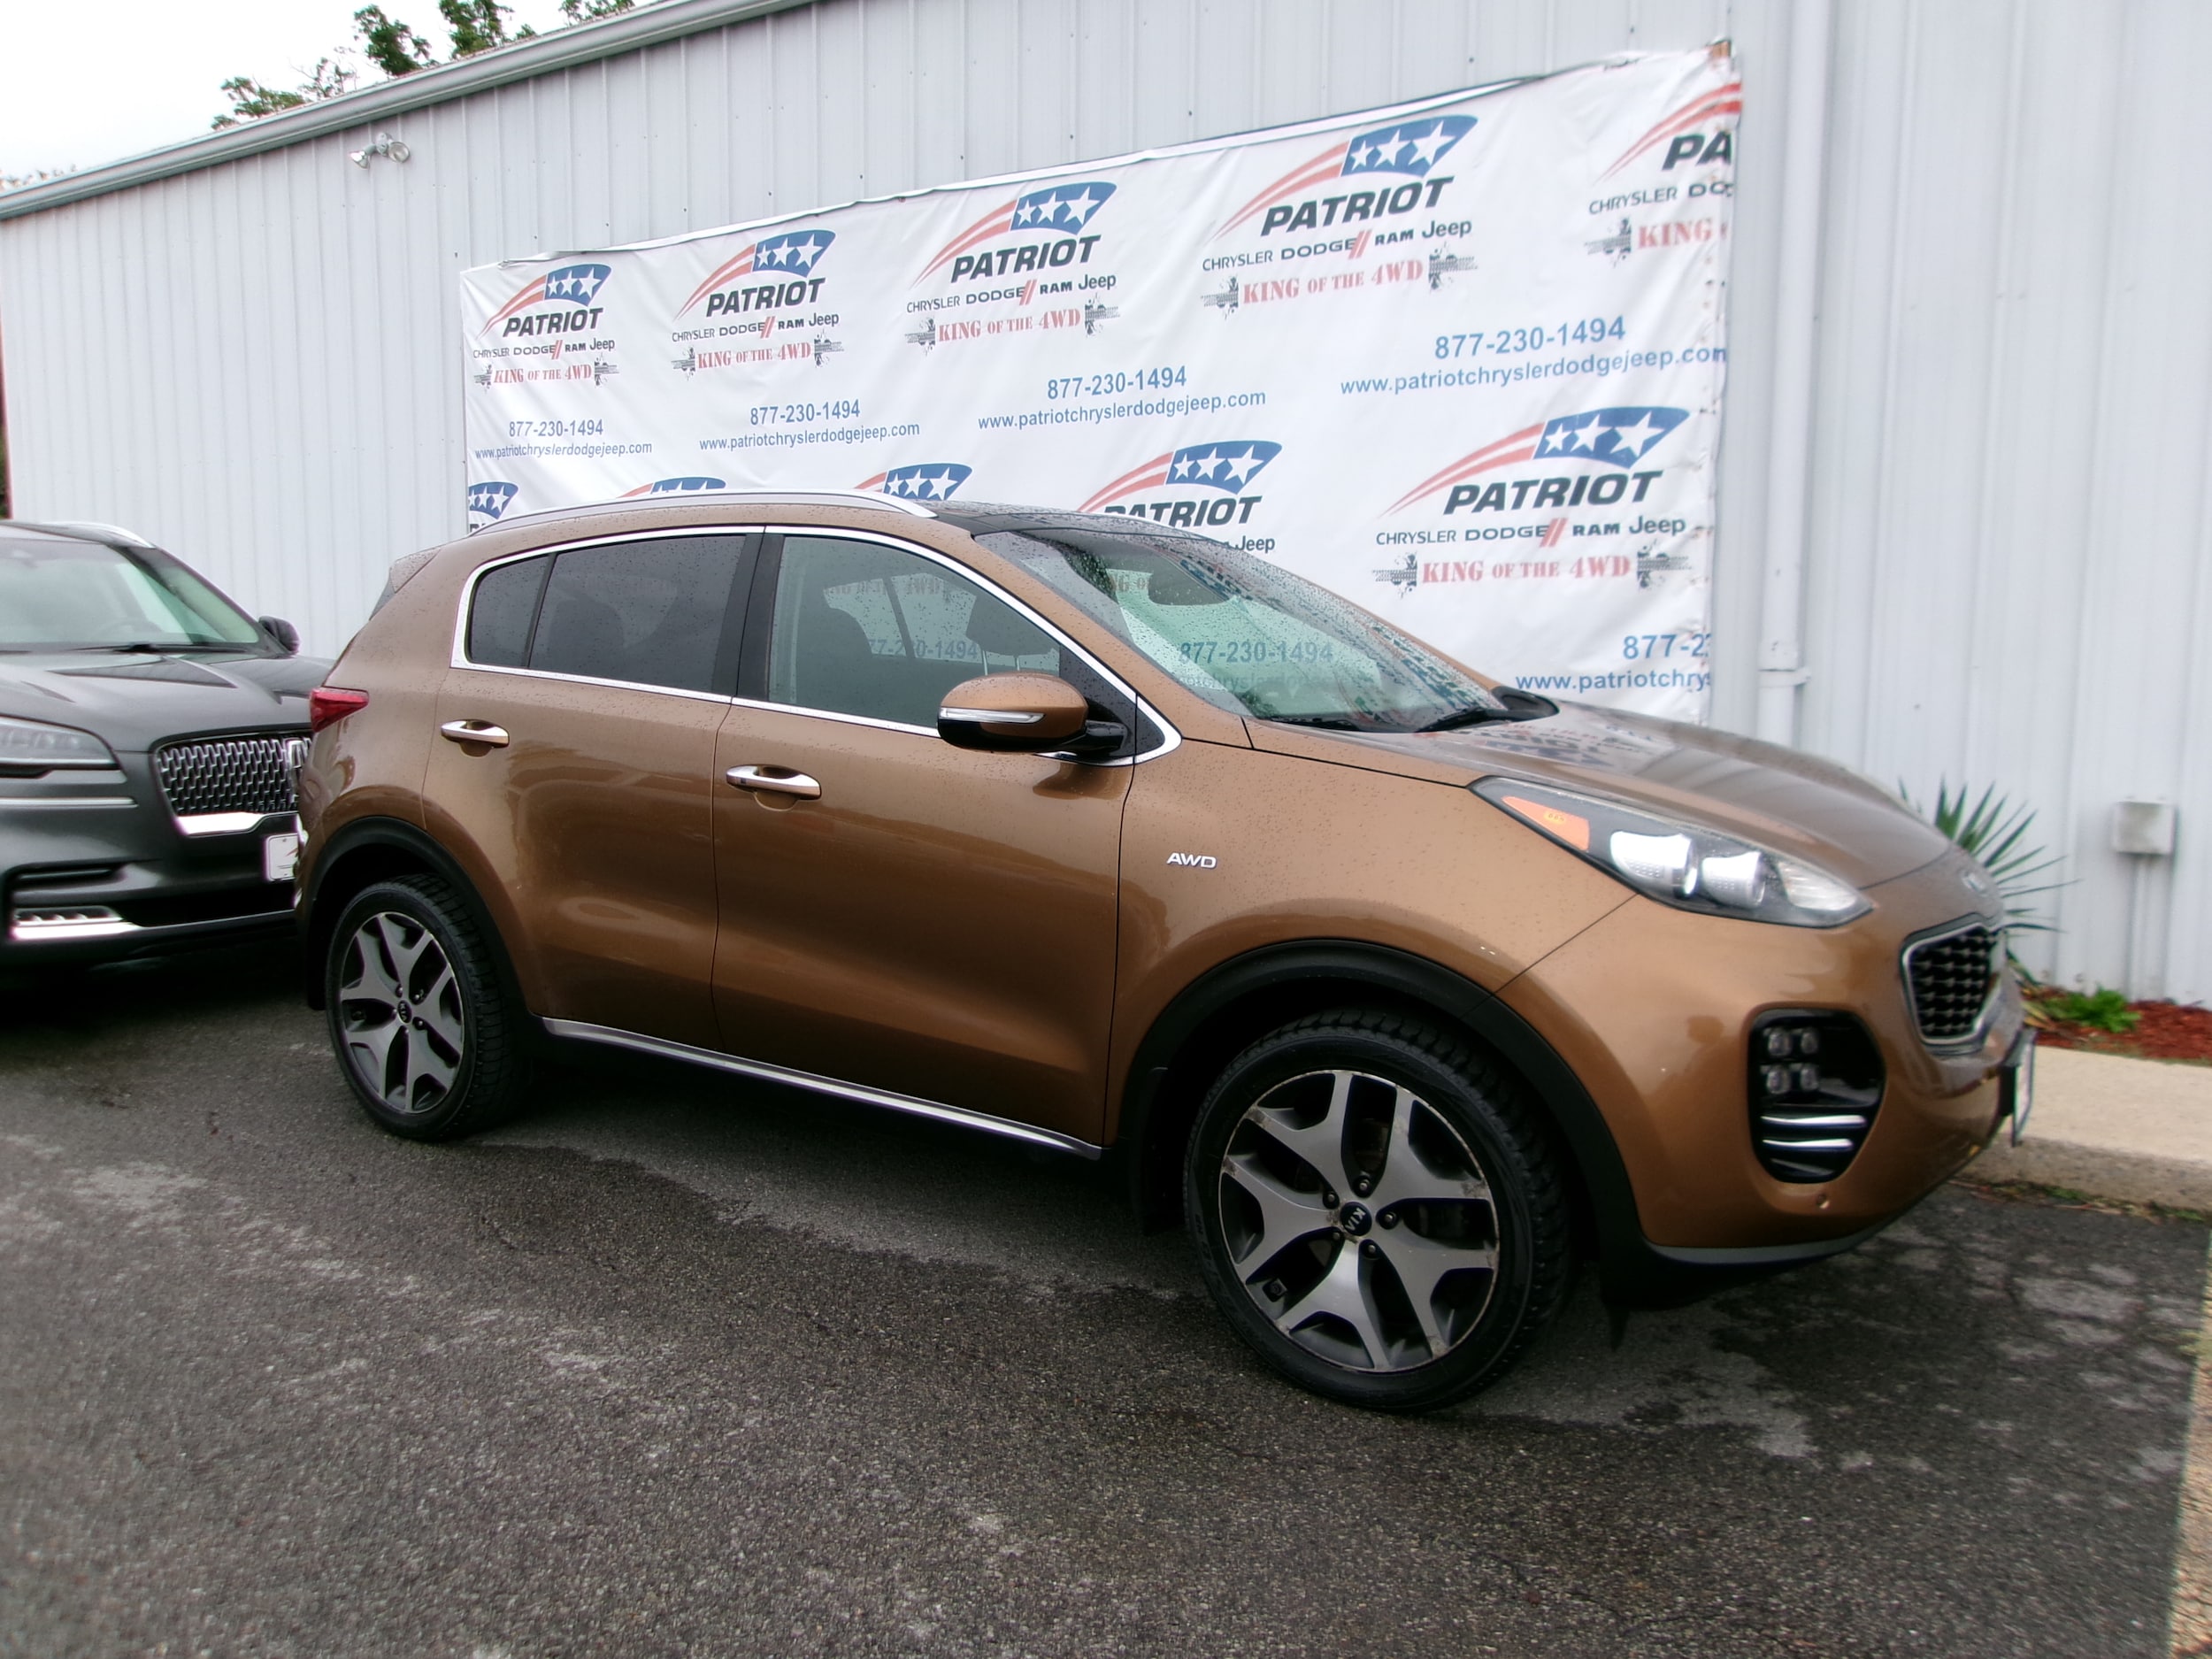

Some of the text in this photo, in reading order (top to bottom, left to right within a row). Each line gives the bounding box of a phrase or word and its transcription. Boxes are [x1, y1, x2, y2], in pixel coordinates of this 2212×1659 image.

[1260, 175, 1455, 236] PATRIOT
[1589, 186, 1678, 215] CHRYSLER
[1202, 219, 1472, 272] CHRYSLER DODGE RAM Jeep
[1638, 217, 1712, 250] KING
[950, 234, 1102, 283] PATRIOT
[906, 273, 1117, 313] CHRYSLER DODGE RAM Jeep
[1243, 258, 1424, 304] KING OF THE 4WD
[706, 277, 826, 318] PATRIOT
[502, 307, 603, 337] PATRIOT
[672, 312, 840, 342] CHRYSLER DODGE RAM Jeep
[939, 308, 1081, 342] KING OF THE 4WD
[472, 337, 615, 358] CHRYSLER DODGE RAM Jeep
[1434, 314, 1626, 361] 877-230-1494
[697, 342, 811, 369] KING OF THE 4WD
[493, 364, 592, 383] KING OF THE 4WD
[1047, 365, 1187, 400] 877-230-1494
[750, 398, 861, 426] 877-230-1494
[978, 392, 1266, 430] www.patriotchryslerdodgejeep.com
[509, 419, 603, 438] 877-230-1494
[699, 423, 920, 451] www.patriotchryslerdodgejeep.com
[475, 442, 653, 460] www.patriotchryslerdodgejeep.com
[1443, 470, 1663, 516] PATRIOT
[1236, 535, 1276, 553] Jeep
[1376, 515, 1686, 545] CHRYSLER DODGE RAM Jeep
[1422, 555, 1632, 584] KING OF THE 4WD
[1180, 641, 1333, 664] 877-230-1494
[1166, 852, 1217, 869] AWD
[1344, 1207, 1366, 1231] KIA
